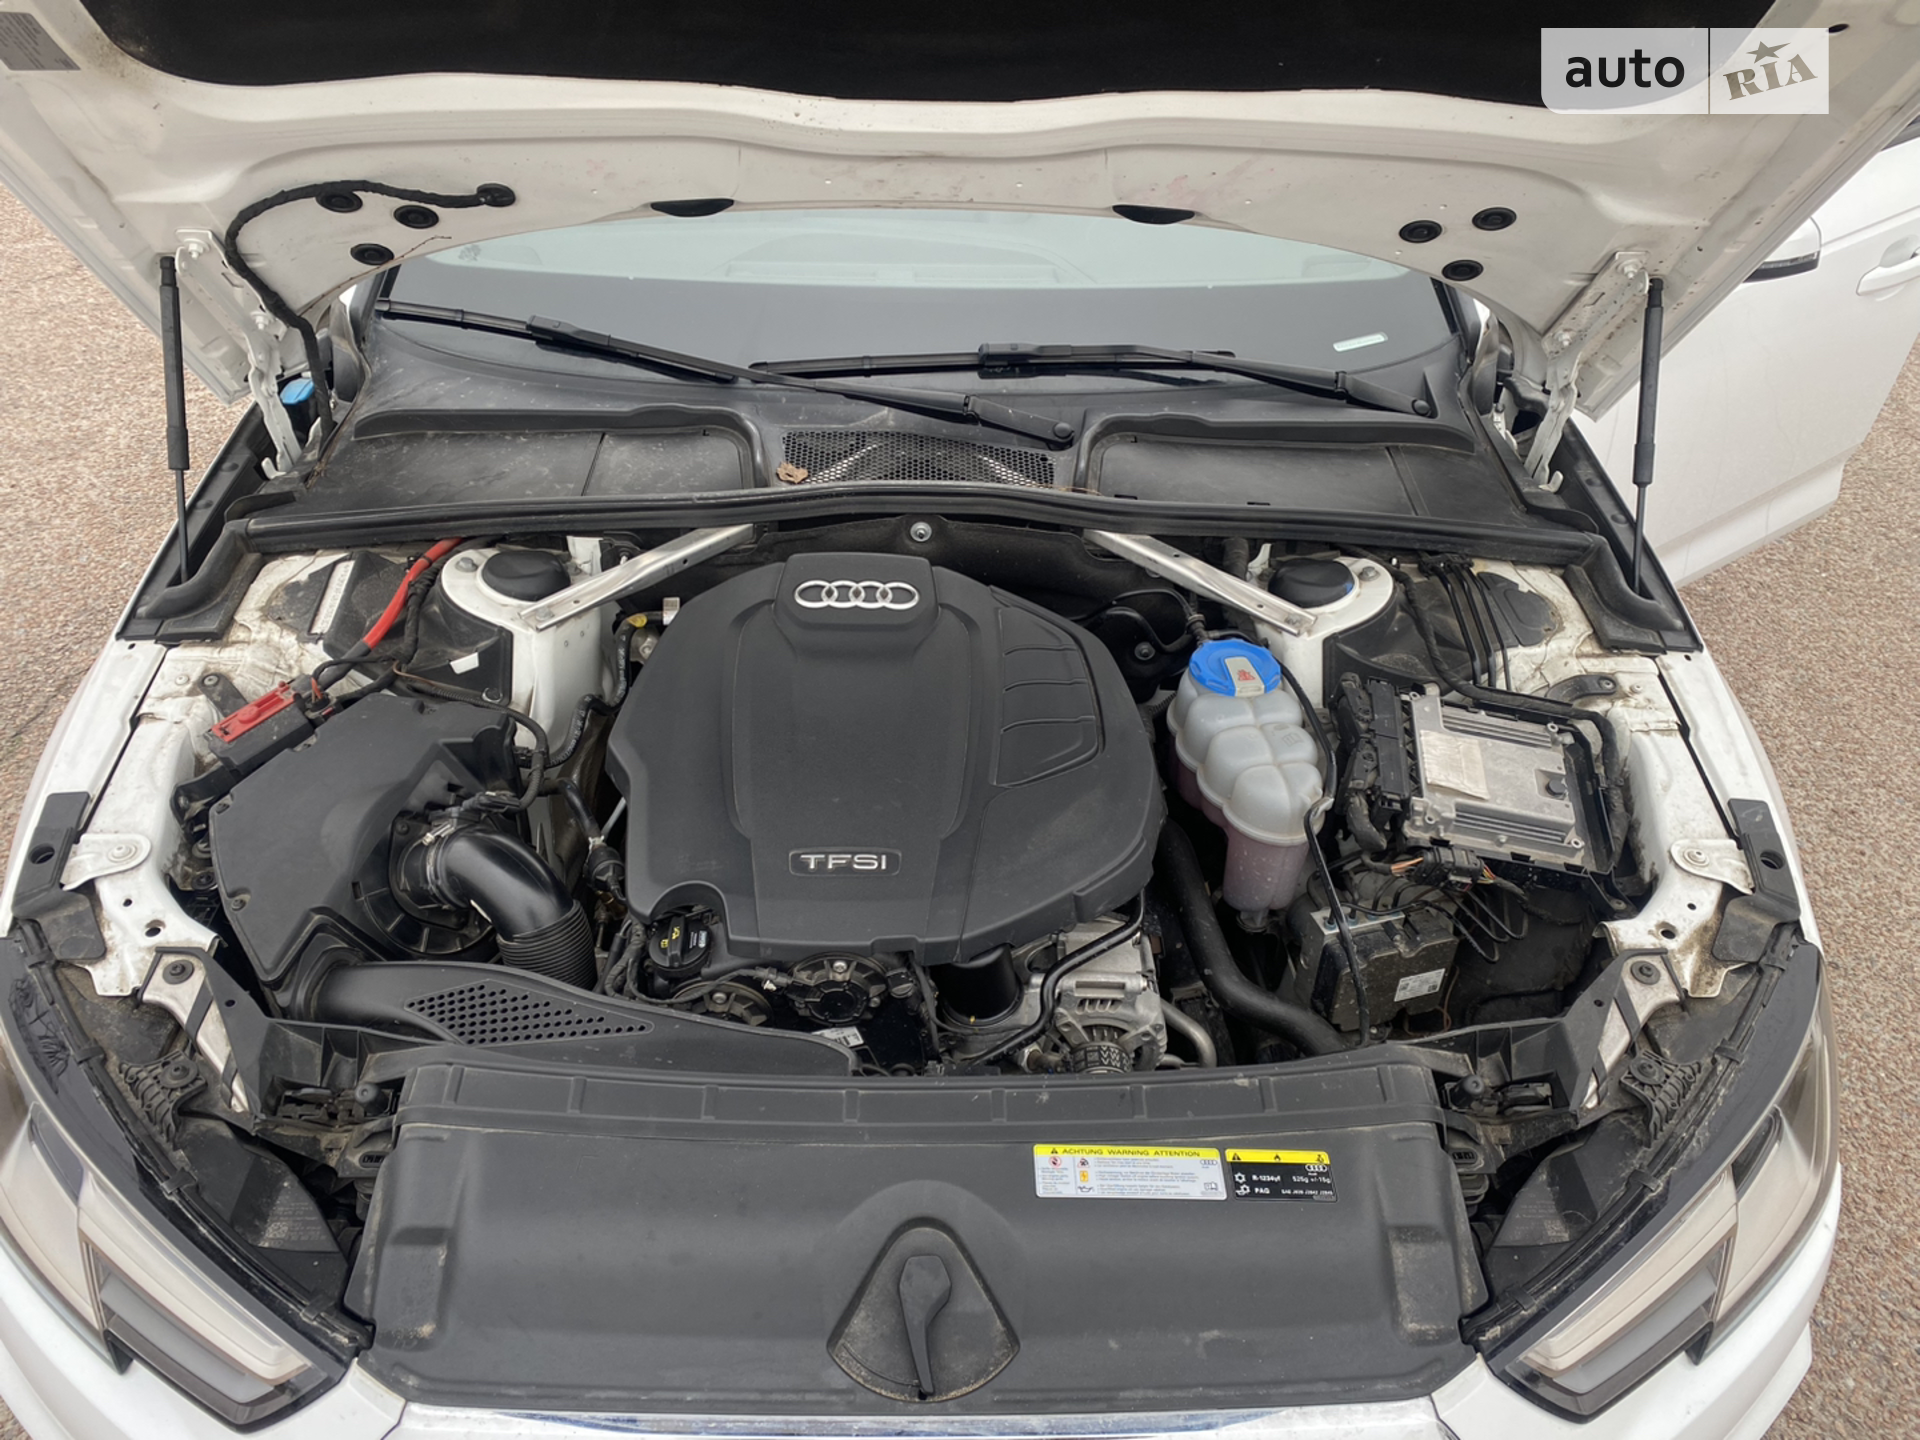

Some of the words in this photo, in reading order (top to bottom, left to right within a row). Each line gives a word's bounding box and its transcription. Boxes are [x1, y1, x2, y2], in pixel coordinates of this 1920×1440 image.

[800, 854, 887, 870] TFSI
[1062, 1148, 1103, 1156] ACHTUNG
[1107, 1148, 1149, 1157] WARNING
[1154, 1149, 1200, 1158] ATTENTION
